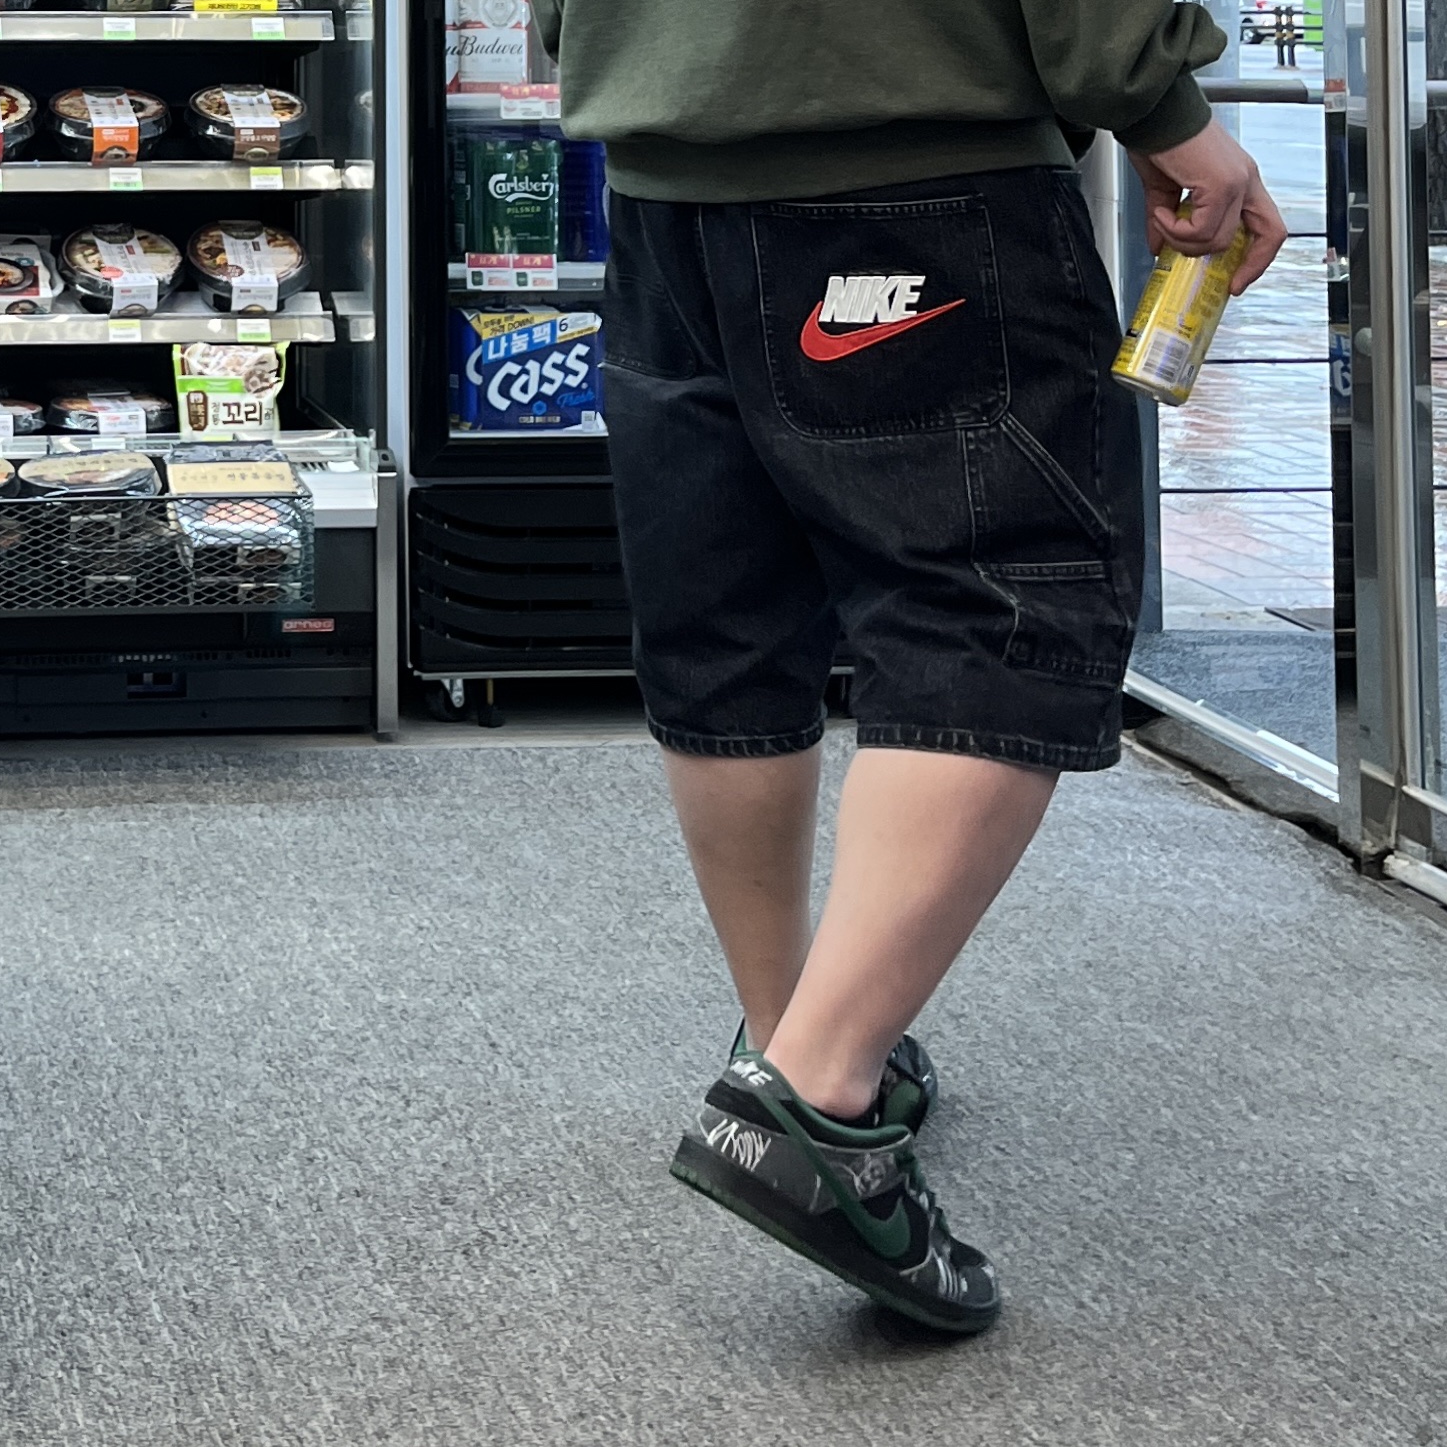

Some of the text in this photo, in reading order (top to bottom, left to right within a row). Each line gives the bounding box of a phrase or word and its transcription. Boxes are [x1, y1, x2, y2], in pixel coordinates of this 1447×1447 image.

[459, 35, 523, 56] Budwei
[506, 206, 542, 215] PILSNER
[818, 275, 926, 324] NIKE
[558, 317, 569, 332] 6
[487, 320, 552, 360] 나눔팩
[222, 401, 263, 426] 꼬리
